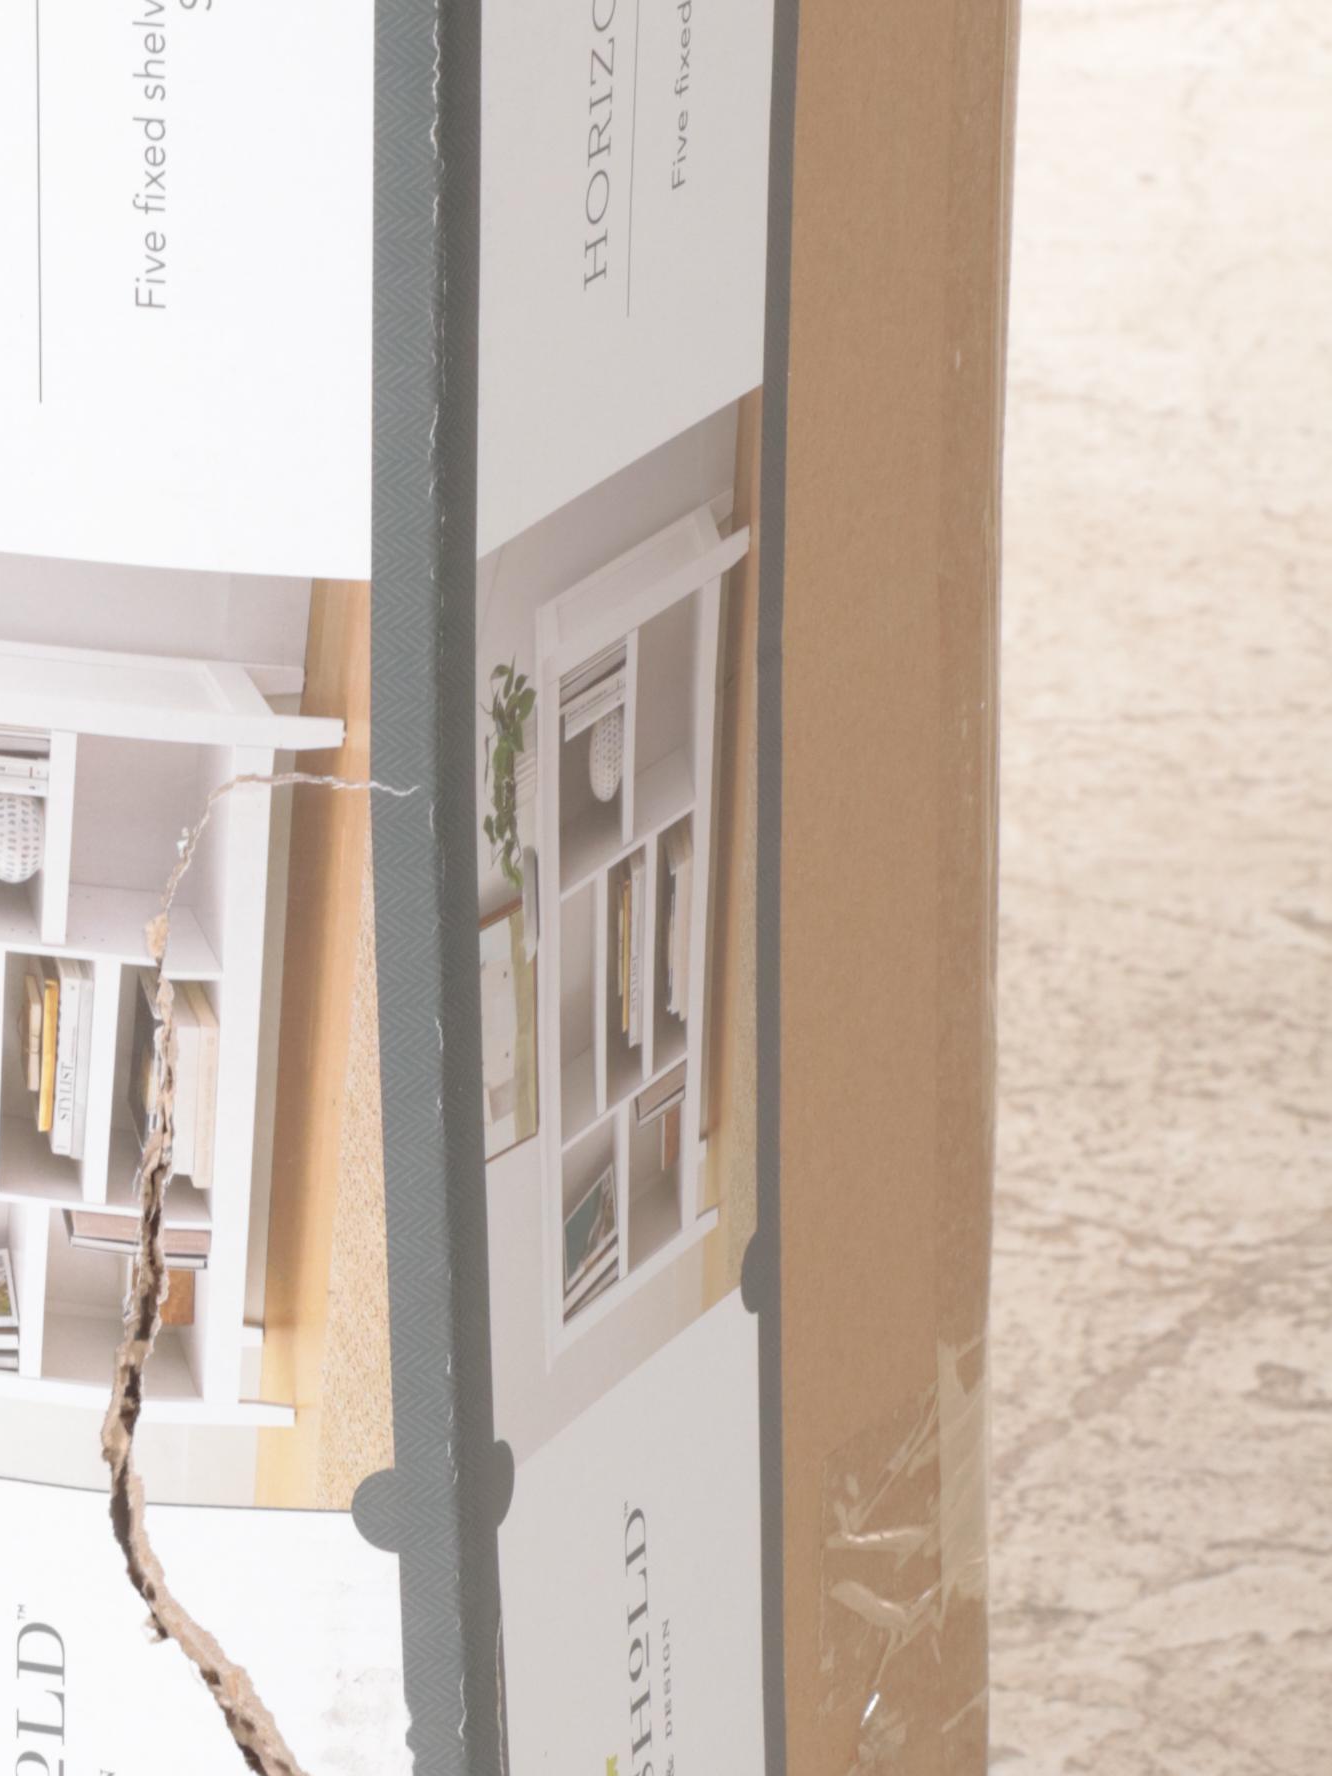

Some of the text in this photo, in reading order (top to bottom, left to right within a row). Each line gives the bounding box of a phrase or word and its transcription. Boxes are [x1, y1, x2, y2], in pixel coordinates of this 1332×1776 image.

[671, 0, 692, 190] Five fixed
[132, 117, 166, 215] fixed
[135, 231, 166, 309] Five
[662, 1619, 674, 1740] DESIGN
